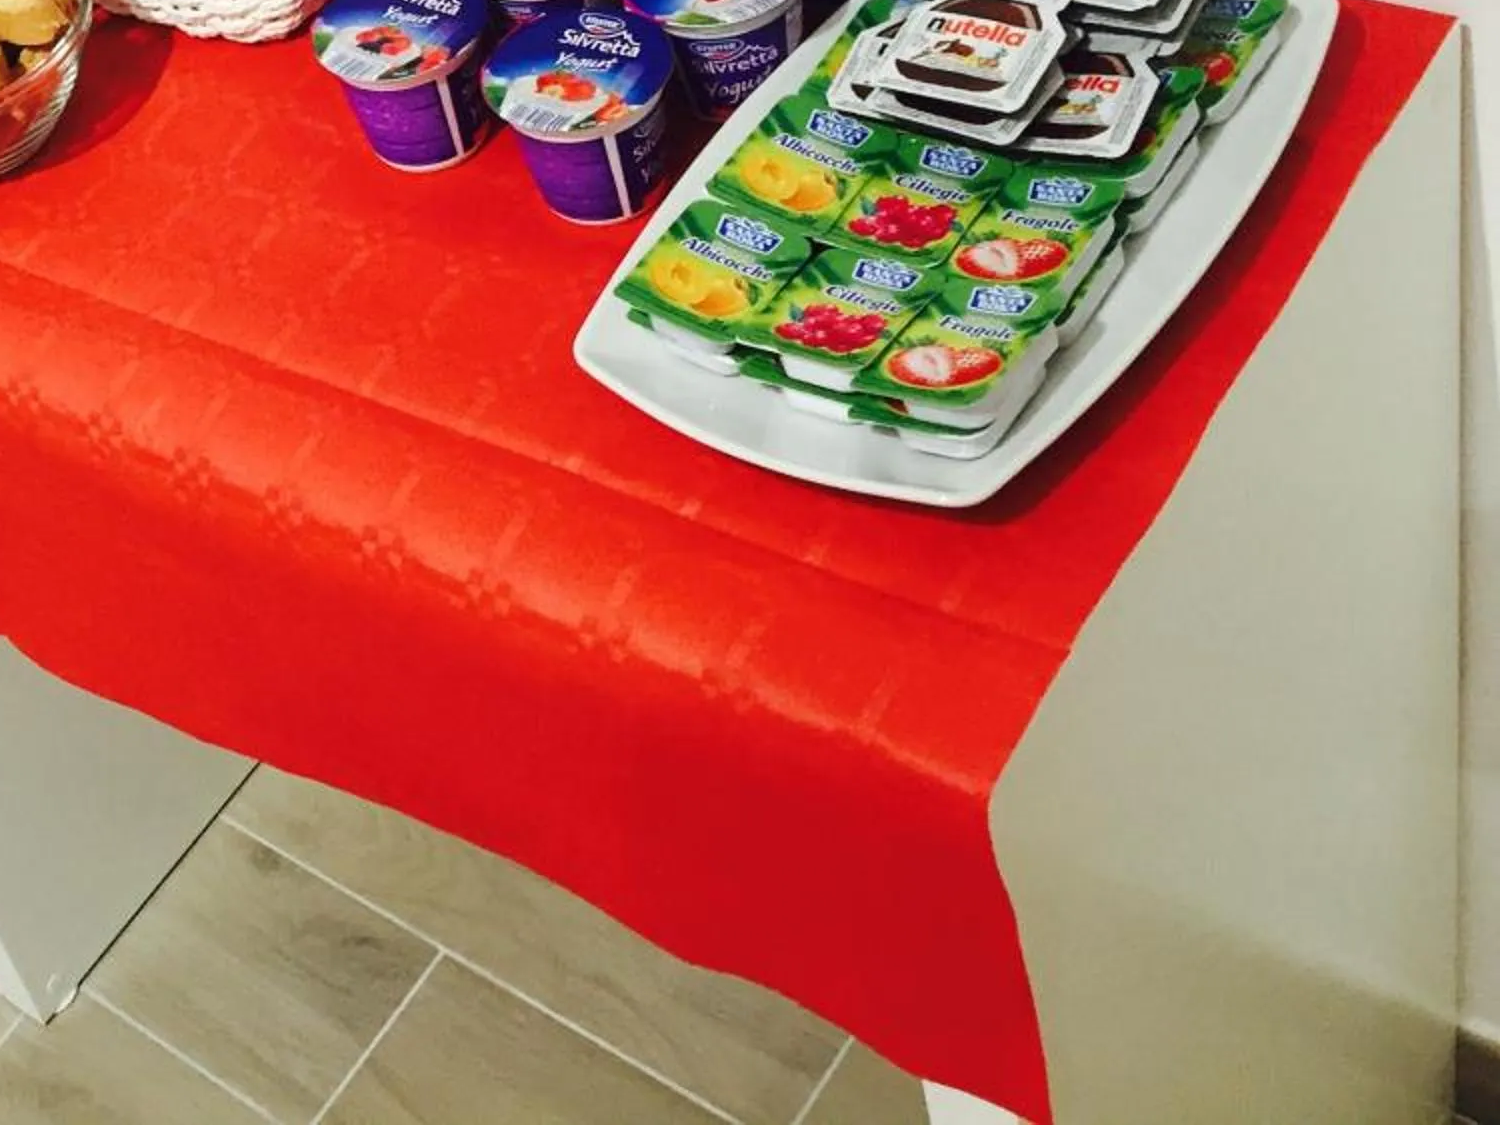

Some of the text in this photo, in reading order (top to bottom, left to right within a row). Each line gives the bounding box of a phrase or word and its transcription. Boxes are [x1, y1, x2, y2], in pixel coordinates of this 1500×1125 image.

[382, 5, 439, 25] Yogurt
[558, 29, 641, 58] Silvretta
[927, 17, 1027, 46] nutella
[555, 52, 618, 71] Yogurt
[1063, 76, 1120, 93] ella
[773, 133, 860, 173] Albicocche
[895, 174, 969, 202] Ciliegie
[1001, 209, 1080, 231] Fragole
[681, 237, 772, 280] Albicocche
[826, 285, 901, 313] Ciliegie
[940, 315, 1015, 339] Fragole
